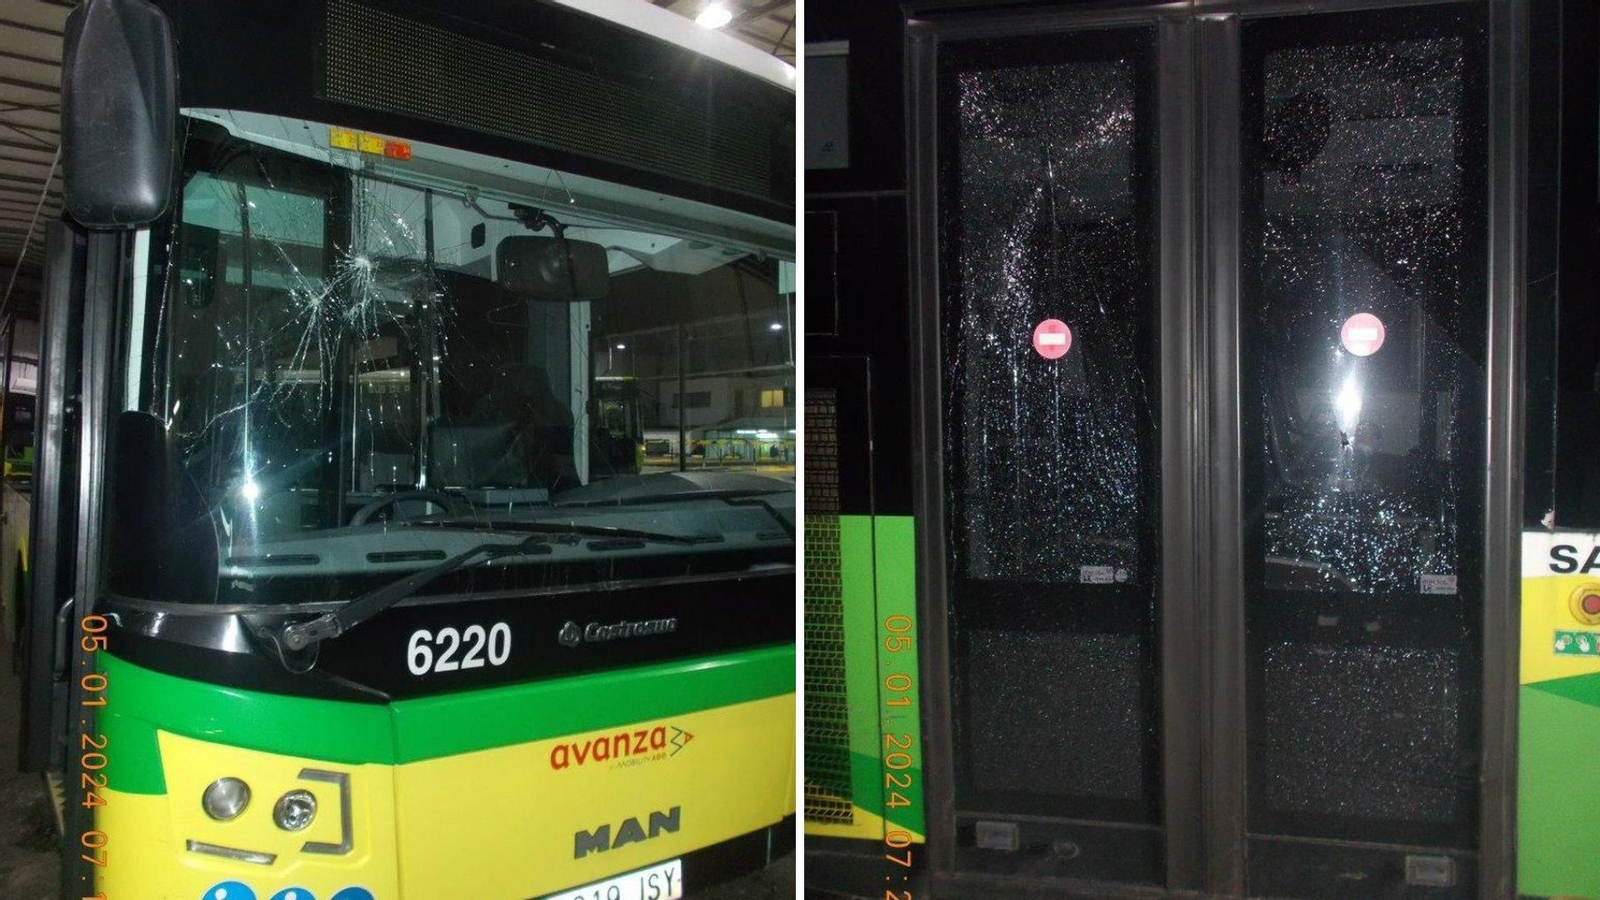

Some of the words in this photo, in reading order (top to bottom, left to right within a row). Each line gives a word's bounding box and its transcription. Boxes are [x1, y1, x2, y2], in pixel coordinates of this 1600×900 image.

[407, 622, 512, 676] 6220
[550, 726, 667, 770] avanza
[574, 806, 681, 860] MAN
